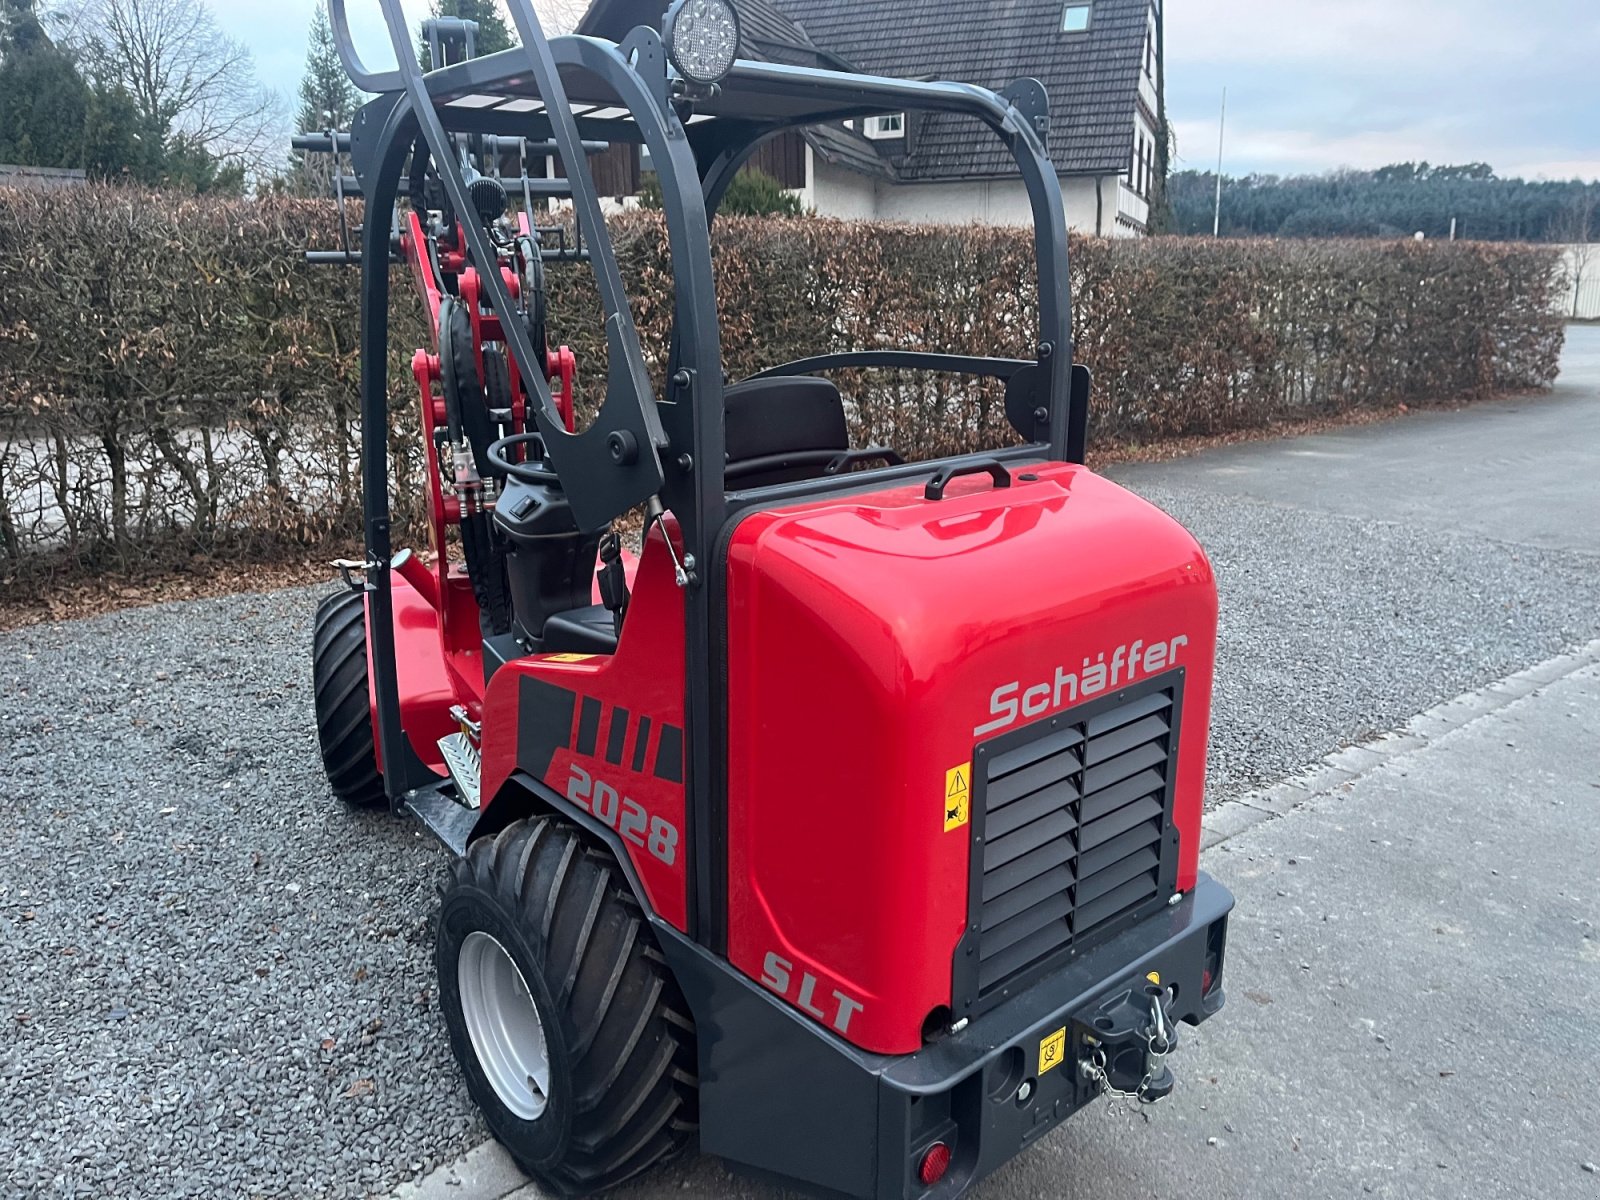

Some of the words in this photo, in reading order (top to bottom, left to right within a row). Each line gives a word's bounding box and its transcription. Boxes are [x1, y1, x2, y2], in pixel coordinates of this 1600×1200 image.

[973, 634, 1189, 737] Schäffer
[567, 763, 679, 866] 2028
[760, 950, 864, 1034] SLT
